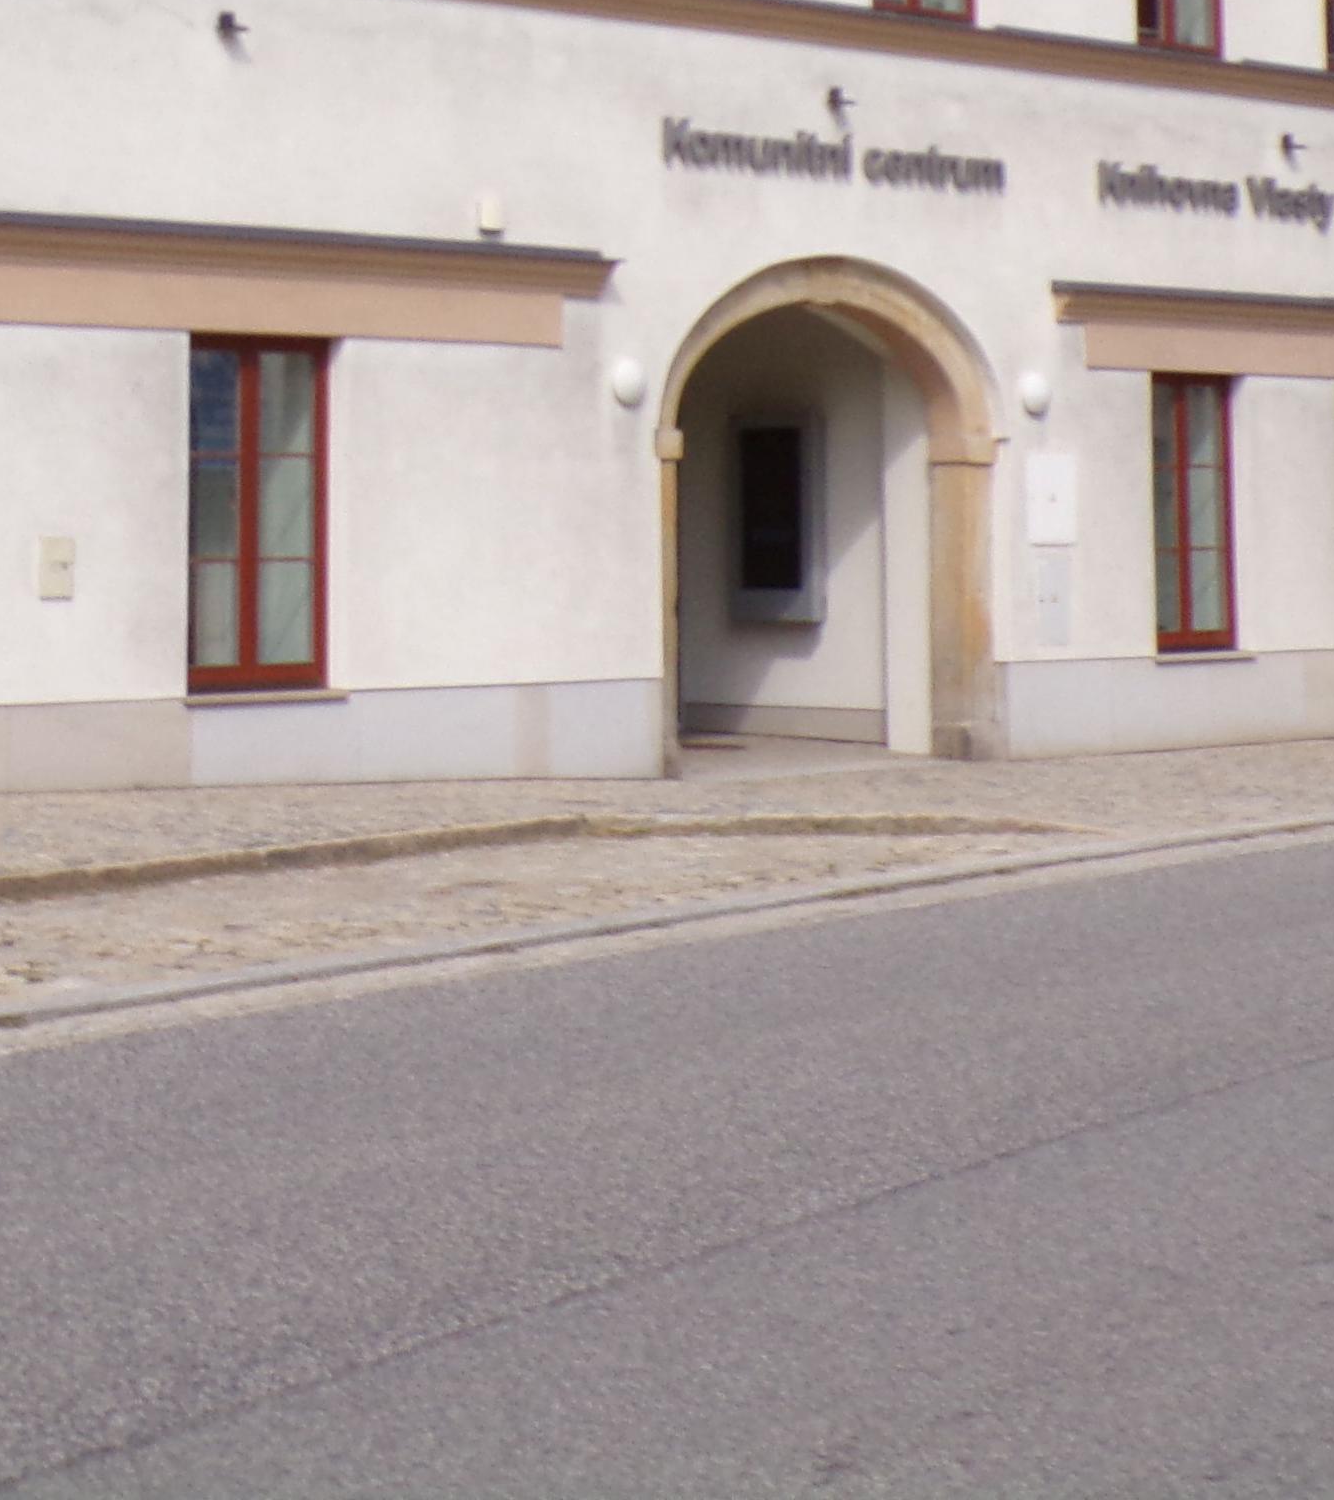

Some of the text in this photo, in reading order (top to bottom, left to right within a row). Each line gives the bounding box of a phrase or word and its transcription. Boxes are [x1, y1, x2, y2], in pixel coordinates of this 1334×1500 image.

[662, 116, 1007, 196] Komunitní centrum
[1097, 158, 1240, 216] Knihovna
[1246, 175, 1334, 235] Vlasty
